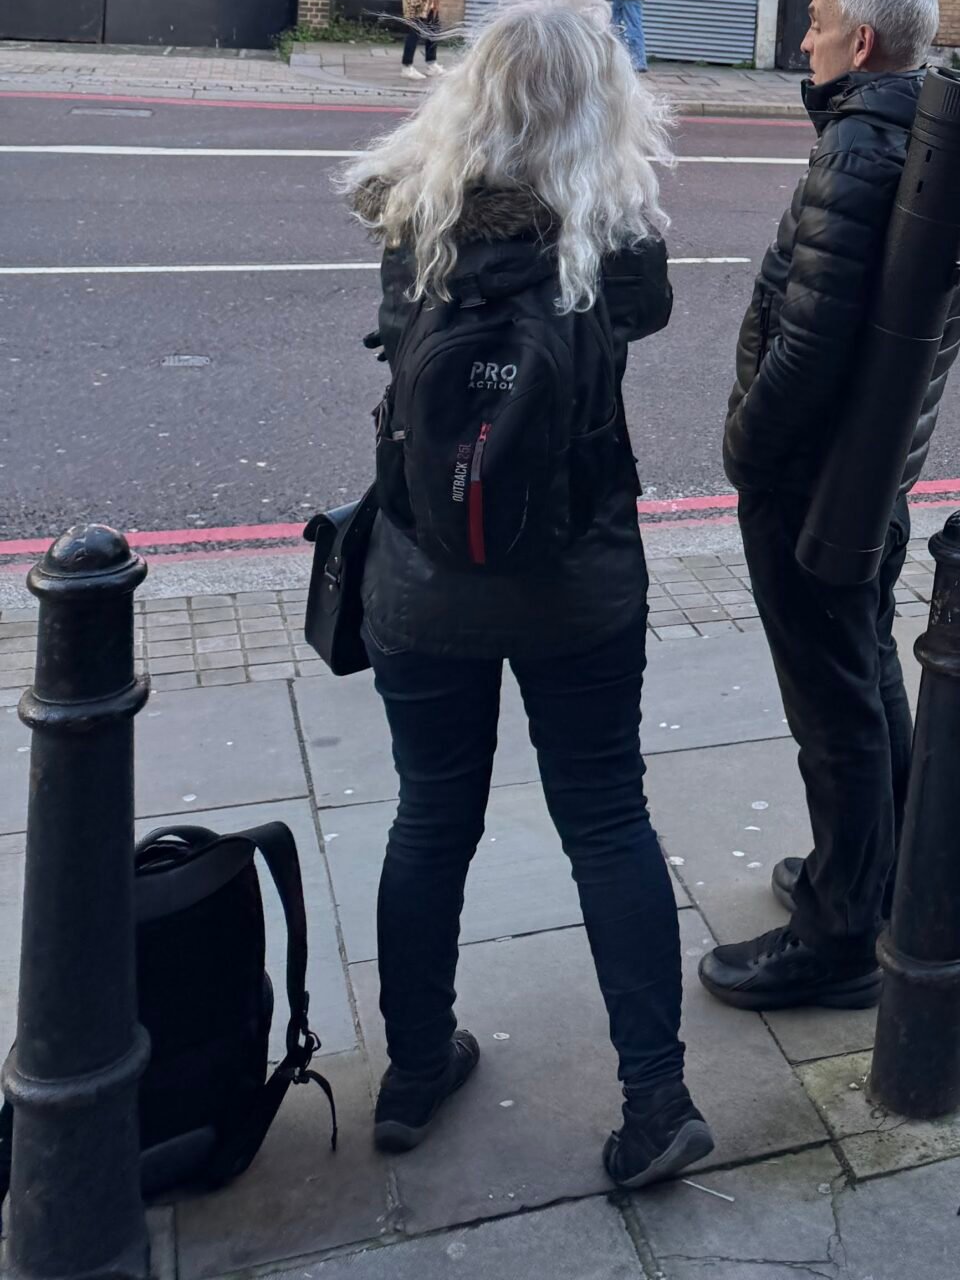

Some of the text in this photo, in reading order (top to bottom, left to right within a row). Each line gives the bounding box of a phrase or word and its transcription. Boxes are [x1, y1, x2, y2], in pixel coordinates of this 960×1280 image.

[469, 361, 518, 382] PRO
[468, 380, 515, 390] ACTION
[451, 461, 468, 503] OUTBACK
